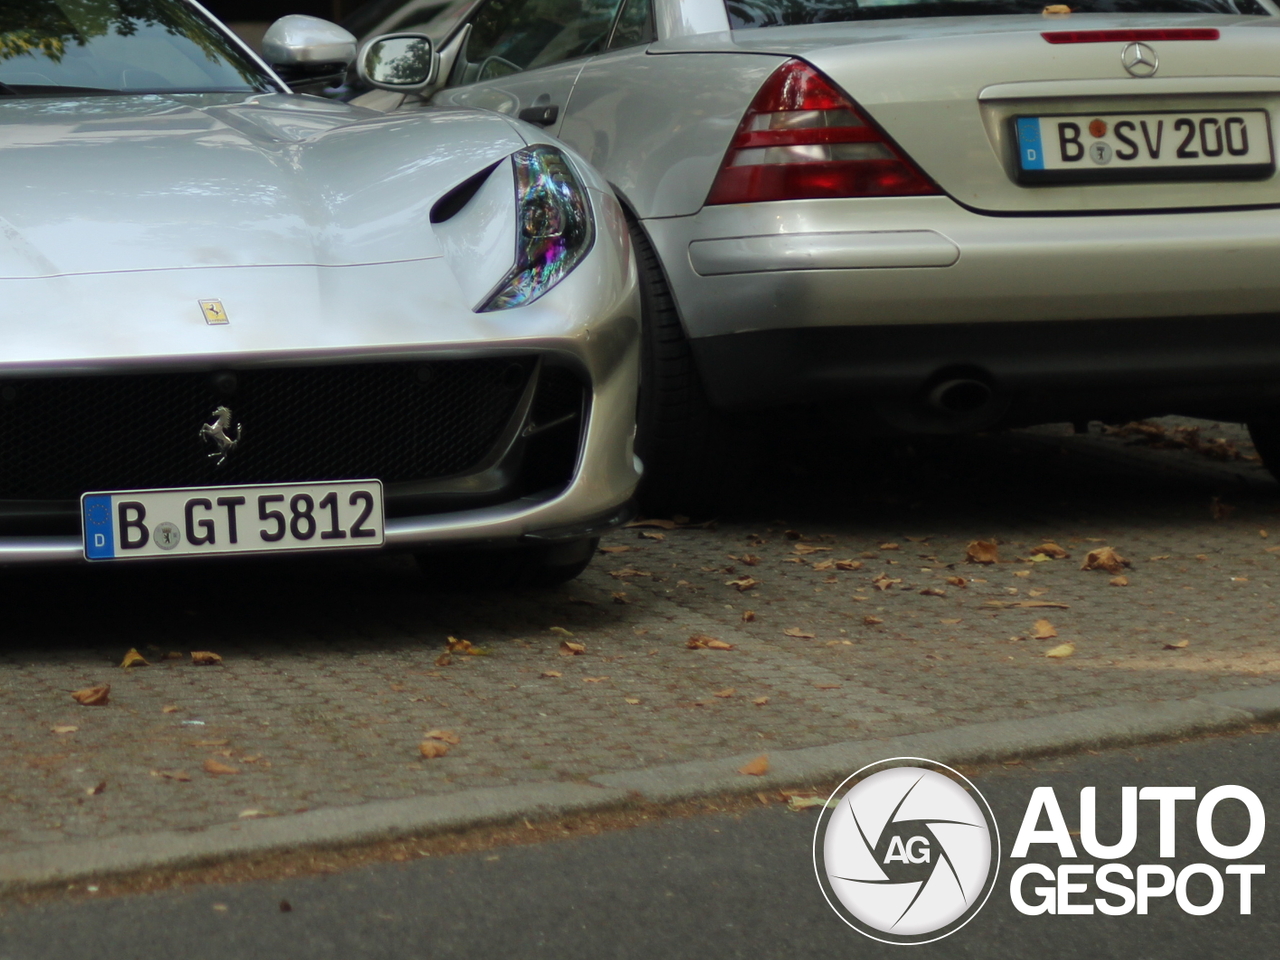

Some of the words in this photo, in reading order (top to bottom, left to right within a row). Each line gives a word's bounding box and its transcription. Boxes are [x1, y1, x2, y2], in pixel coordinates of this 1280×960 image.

[1057, 122, 1084, 162] B
[1113, 120, 1163, 160] SV
[1174, 117, 1249, 158] 200
[1027, 149, 1036, 161] D
[118, 501, 150, 550] B
[184, 496, 246, 546] GT
[257, 490, 376, 542] 5812
[94, 533, 105, 547] D
